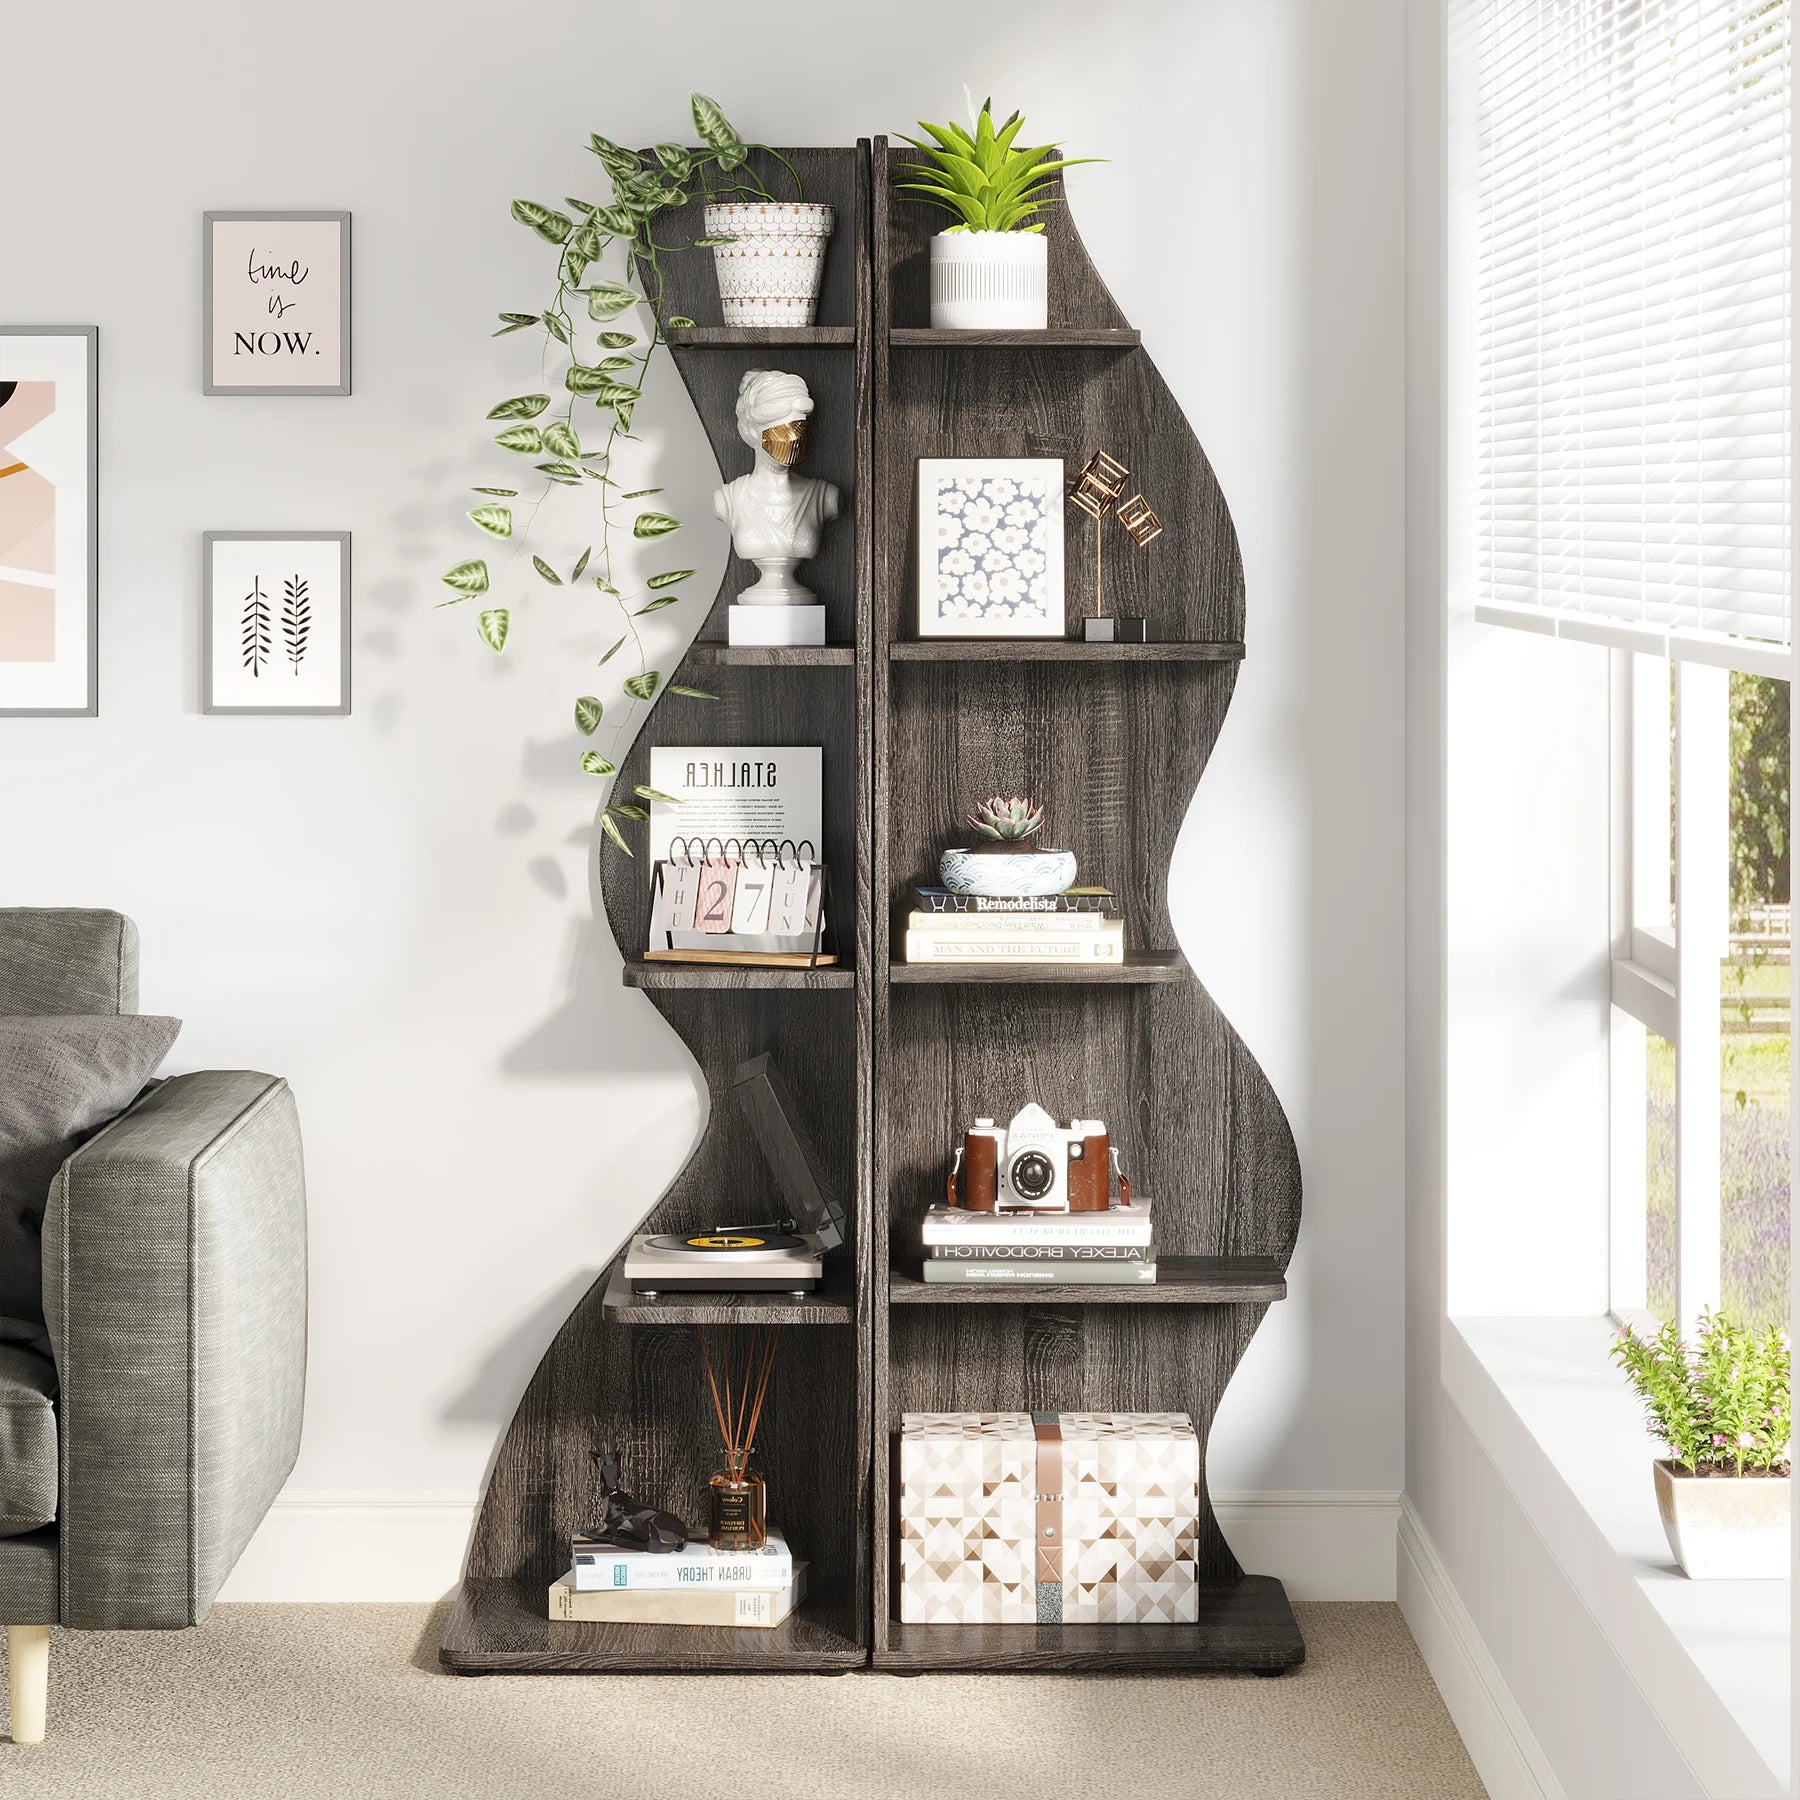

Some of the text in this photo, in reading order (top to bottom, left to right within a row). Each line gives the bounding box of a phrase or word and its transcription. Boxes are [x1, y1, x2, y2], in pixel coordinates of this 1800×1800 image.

[247, 248, 309, 285] time
[268, 289, 296, 319] is
[233, 331, 320, 355] NOW.
[703, 880, 728, 922] 2
[744, 882, 765, 923] 7
[976, 896, 1058, 911] Remodelista
[933, 945, 1081, 954] MAN AND THE FUTURE
